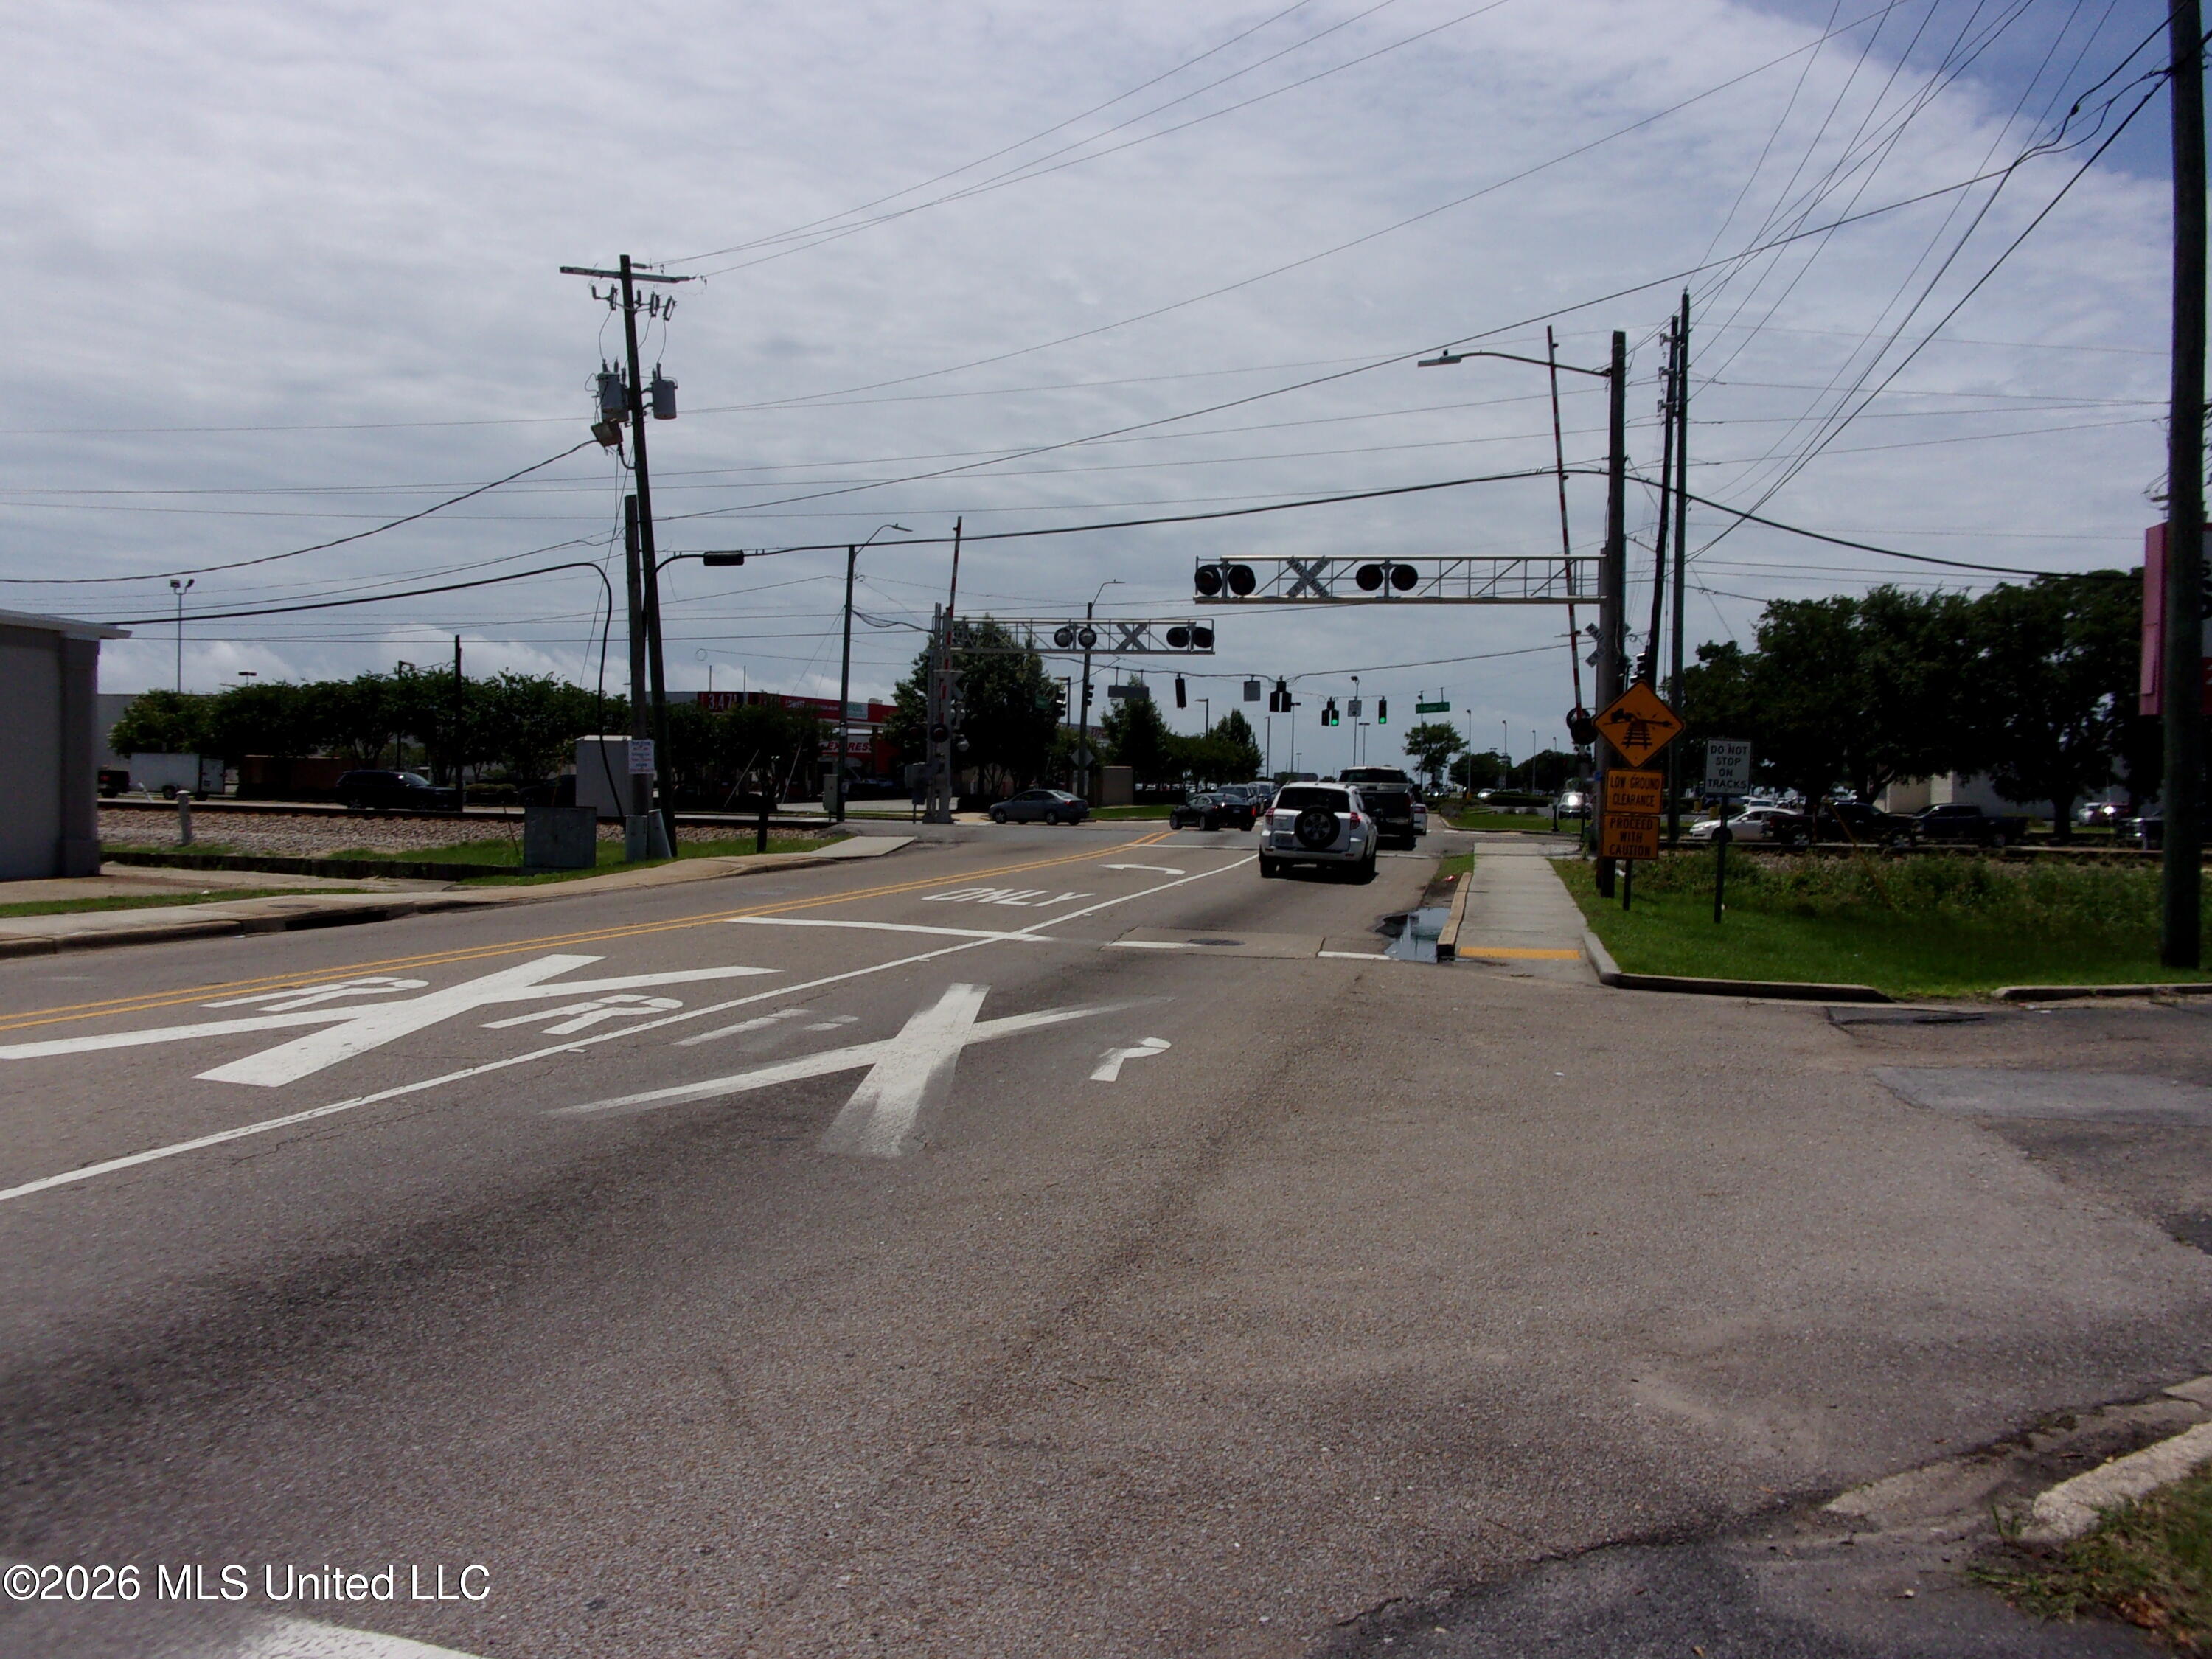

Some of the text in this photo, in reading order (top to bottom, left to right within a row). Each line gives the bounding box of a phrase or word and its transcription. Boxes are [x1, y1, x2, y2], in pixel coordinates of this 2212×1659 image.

[1711, 745, 1747, 754] DO NOT
[1715, 757, 1741, 766] STOP
[1719, 768, 1733, 776] ON
[1610, 775, 1660, 790] LOW GROUND
[1708, 779, 1747, 789] TRACKS
[1612, 793, 1655, 807] CLEARANCE
[1610, 818, 1653, 830] PROCEED
[1619, 831, 1643, 843] WITH
[1610, 843, 1651, 856] CAUTION
[921, 887, 1096, 908] ONLY
